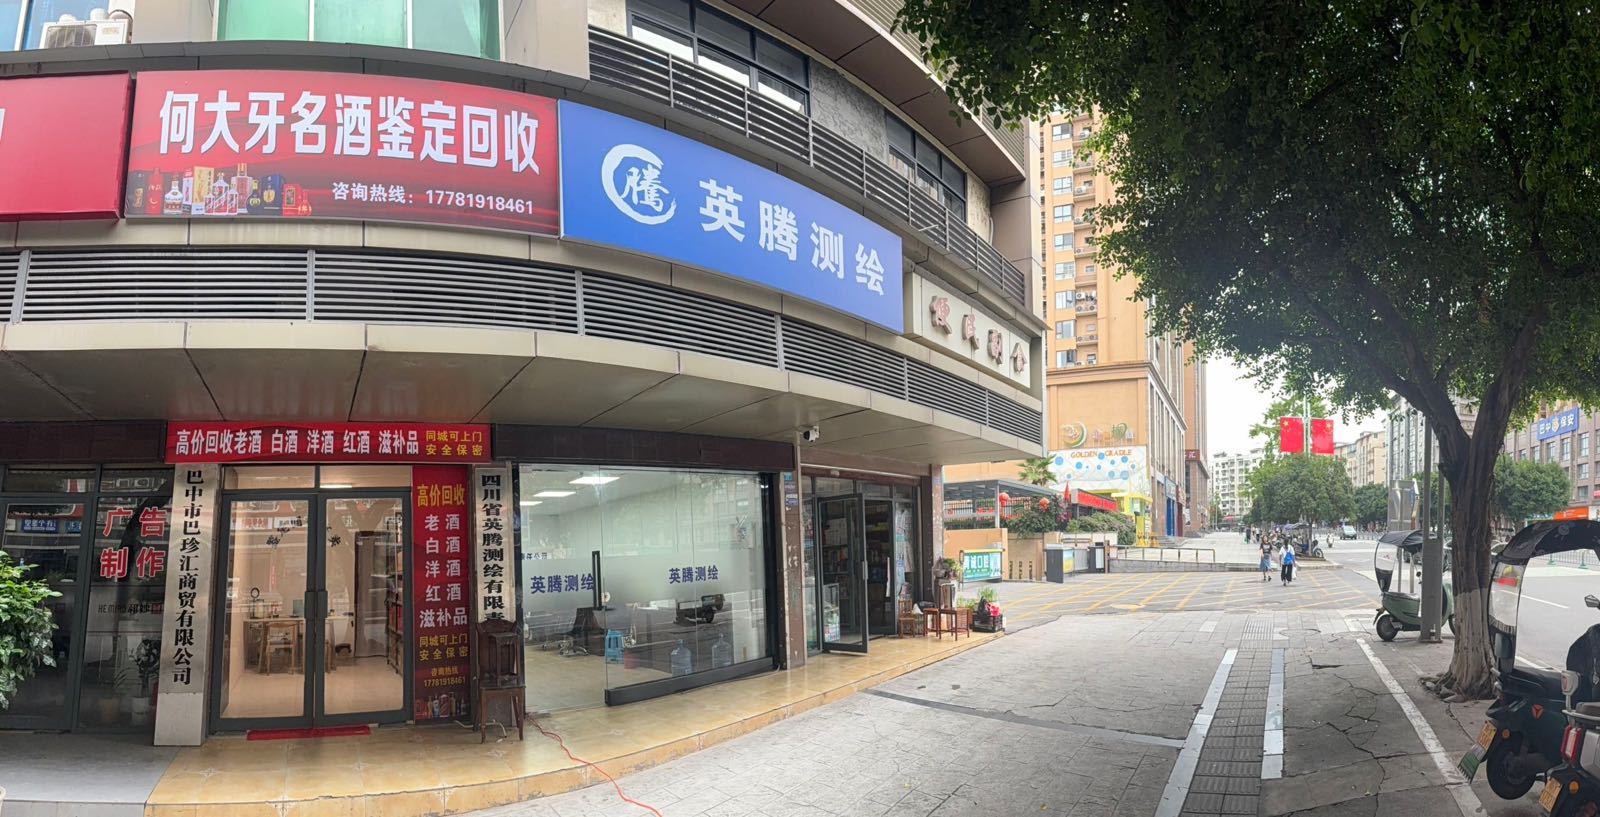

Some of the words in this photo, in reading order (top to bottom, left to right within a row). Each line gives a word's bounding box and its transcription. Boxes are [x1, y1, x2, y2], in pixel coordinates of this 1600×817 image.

[159, 90, 540, 174] 何大牙名酒鉴定回收
[426, 190, 534, 214] 17781918461
[699, 178, 885, 296] 英腾测绘
[175, 430, 262, 455] 高价回收老酒
[271, 429, 298, 453] 白酒
[307, 430, 334, 454] 洋酒
[343, 430, 370, 454] 红酒
[379, 431, 419, 454] 滋补品
[425, 430, 483, 442] 同城可上门
[425, 444, 482, 457] 安全保密
[417, 484, 465, 508] 高价回收
[103, 506, 168, 537] 广告
[425, 513, 460, 531] 老酒
[425, 536, 461, 555] 白酒
[100, 547, 166, 579] 制作
[425, 559, 462, 578] 洋酒
[172, 469, 204, 686] 巴中市巴珍汇商贸有限公司
[531, 573, 594, 594] 英腾测绘
[668, 564, 719, 584] 英腾测绘
[425, 582, 462, 602] 红酒
[419, 607, 468, 628] 滋补品
[419, 633, 468, 648] 同城可上门
[419, 646, 468, 661] 安全保密
